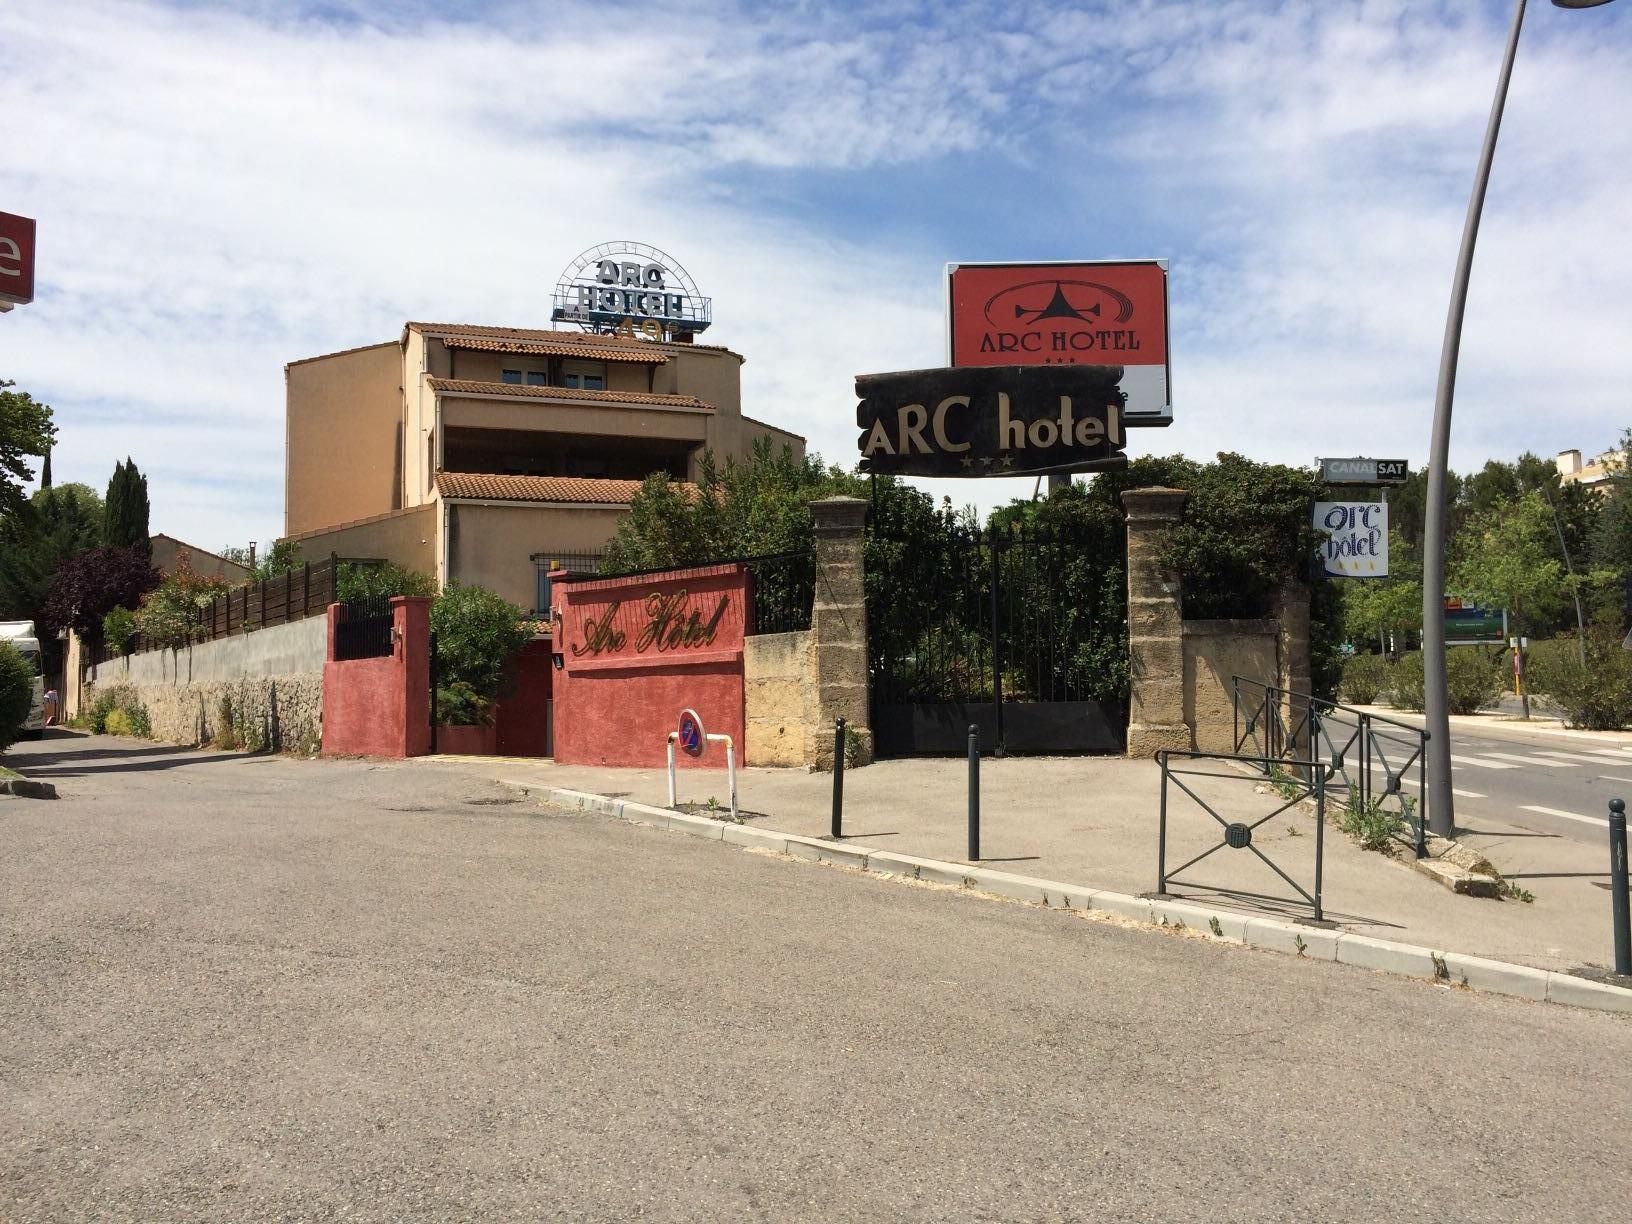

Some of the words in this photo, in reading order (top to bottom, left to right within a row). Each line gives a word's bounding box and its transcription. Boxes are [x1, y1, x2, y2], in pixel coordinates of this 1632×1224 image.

[597, 259, 665, 288] ARC
[578, 284, 682, 317] HOTEL
[979, 331, 1042, 353] ARC
[1051, 330, 1140, 351] HOTEL
[862, 395, 972, 457] ARC
[998, 391, 1120, 450] hotel
[1324, 504, 1381, 531] arc
